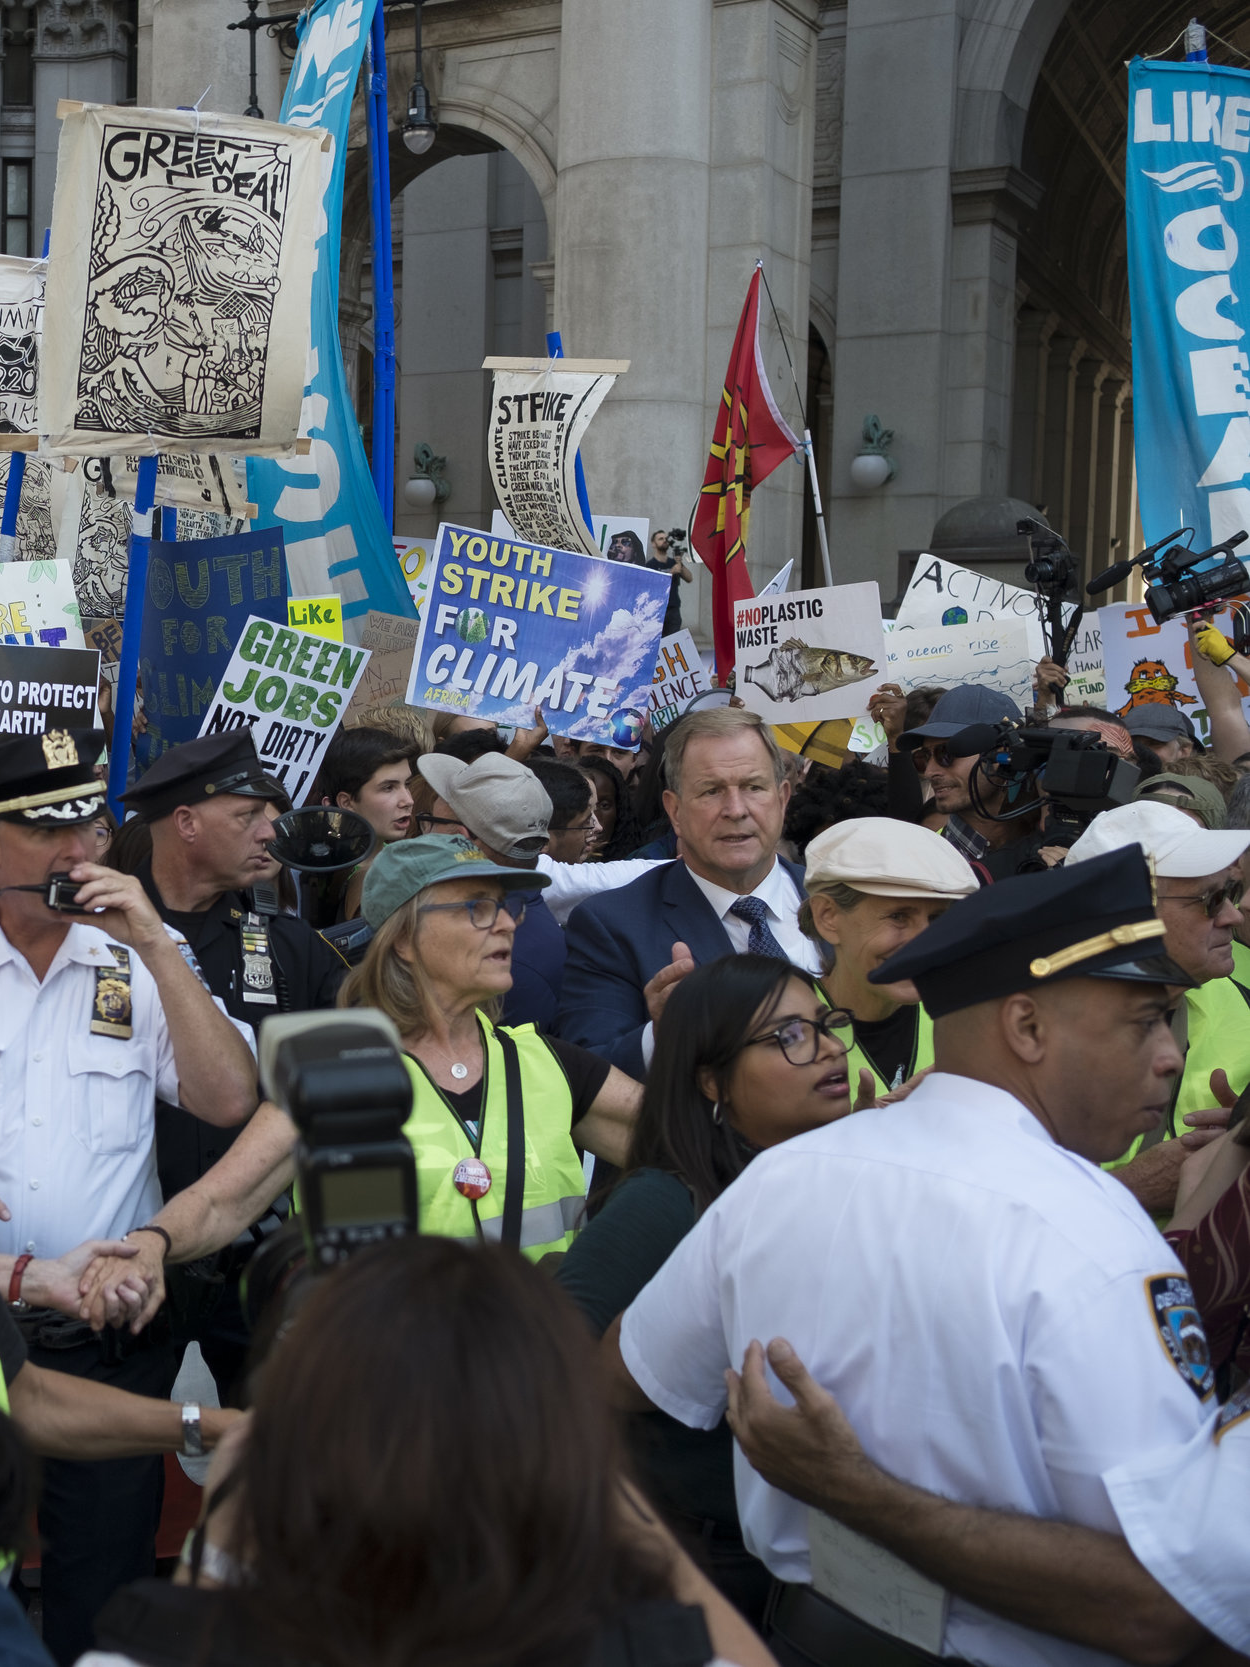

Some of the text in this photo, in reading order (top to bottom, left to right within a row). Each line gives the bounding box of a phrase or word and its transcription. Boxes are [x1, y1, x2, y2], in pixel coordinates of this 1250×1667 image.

[1133, 88, 1250, 153] LIKE
[104, 131, 252, 182] GREEN
[166, 153, 239, 185] NEW
[212, 172, 282, 223] DEAL
[508, 440, 540, 451] HAVE ASKED
[509, 430, 531, 441] STRIKE
[522, 451, 530, 460] UP
[495, 425, 508, 490] CLIMATE
[449, 530, 553, 577] YOUTH
[149, 546, 281, 610] OUTH
[440, 563, 582, 622] STRIKE
[912, 560, 1041, 617] ACT NO
[161, 615, 232, 656] FOR
[369, 614, 392, 633] WE
[434, 603, 518, 652] FOR
[736, 598, 824, 630] #NOPLASTIC
[238, 620, 364, 691] GREEN
[363, 629, 383, 644] ON
[736, 627, 779, 649] WASTE
[907, 637, 1000, 659] oceans rise
[18, 681, 96, 709] PROTECT
[142, 657, 215, 717] CLIM
[222, 667, 343, 729] JOBS
[424, 685, 471, 708] AFRICA
[425, 643, 618, 719] CLIMATE
[1078, 681, 1105, 696] FUND
[651, 702, 679, 729] ARTH
[260, 721, 327, 766] DIRTY
